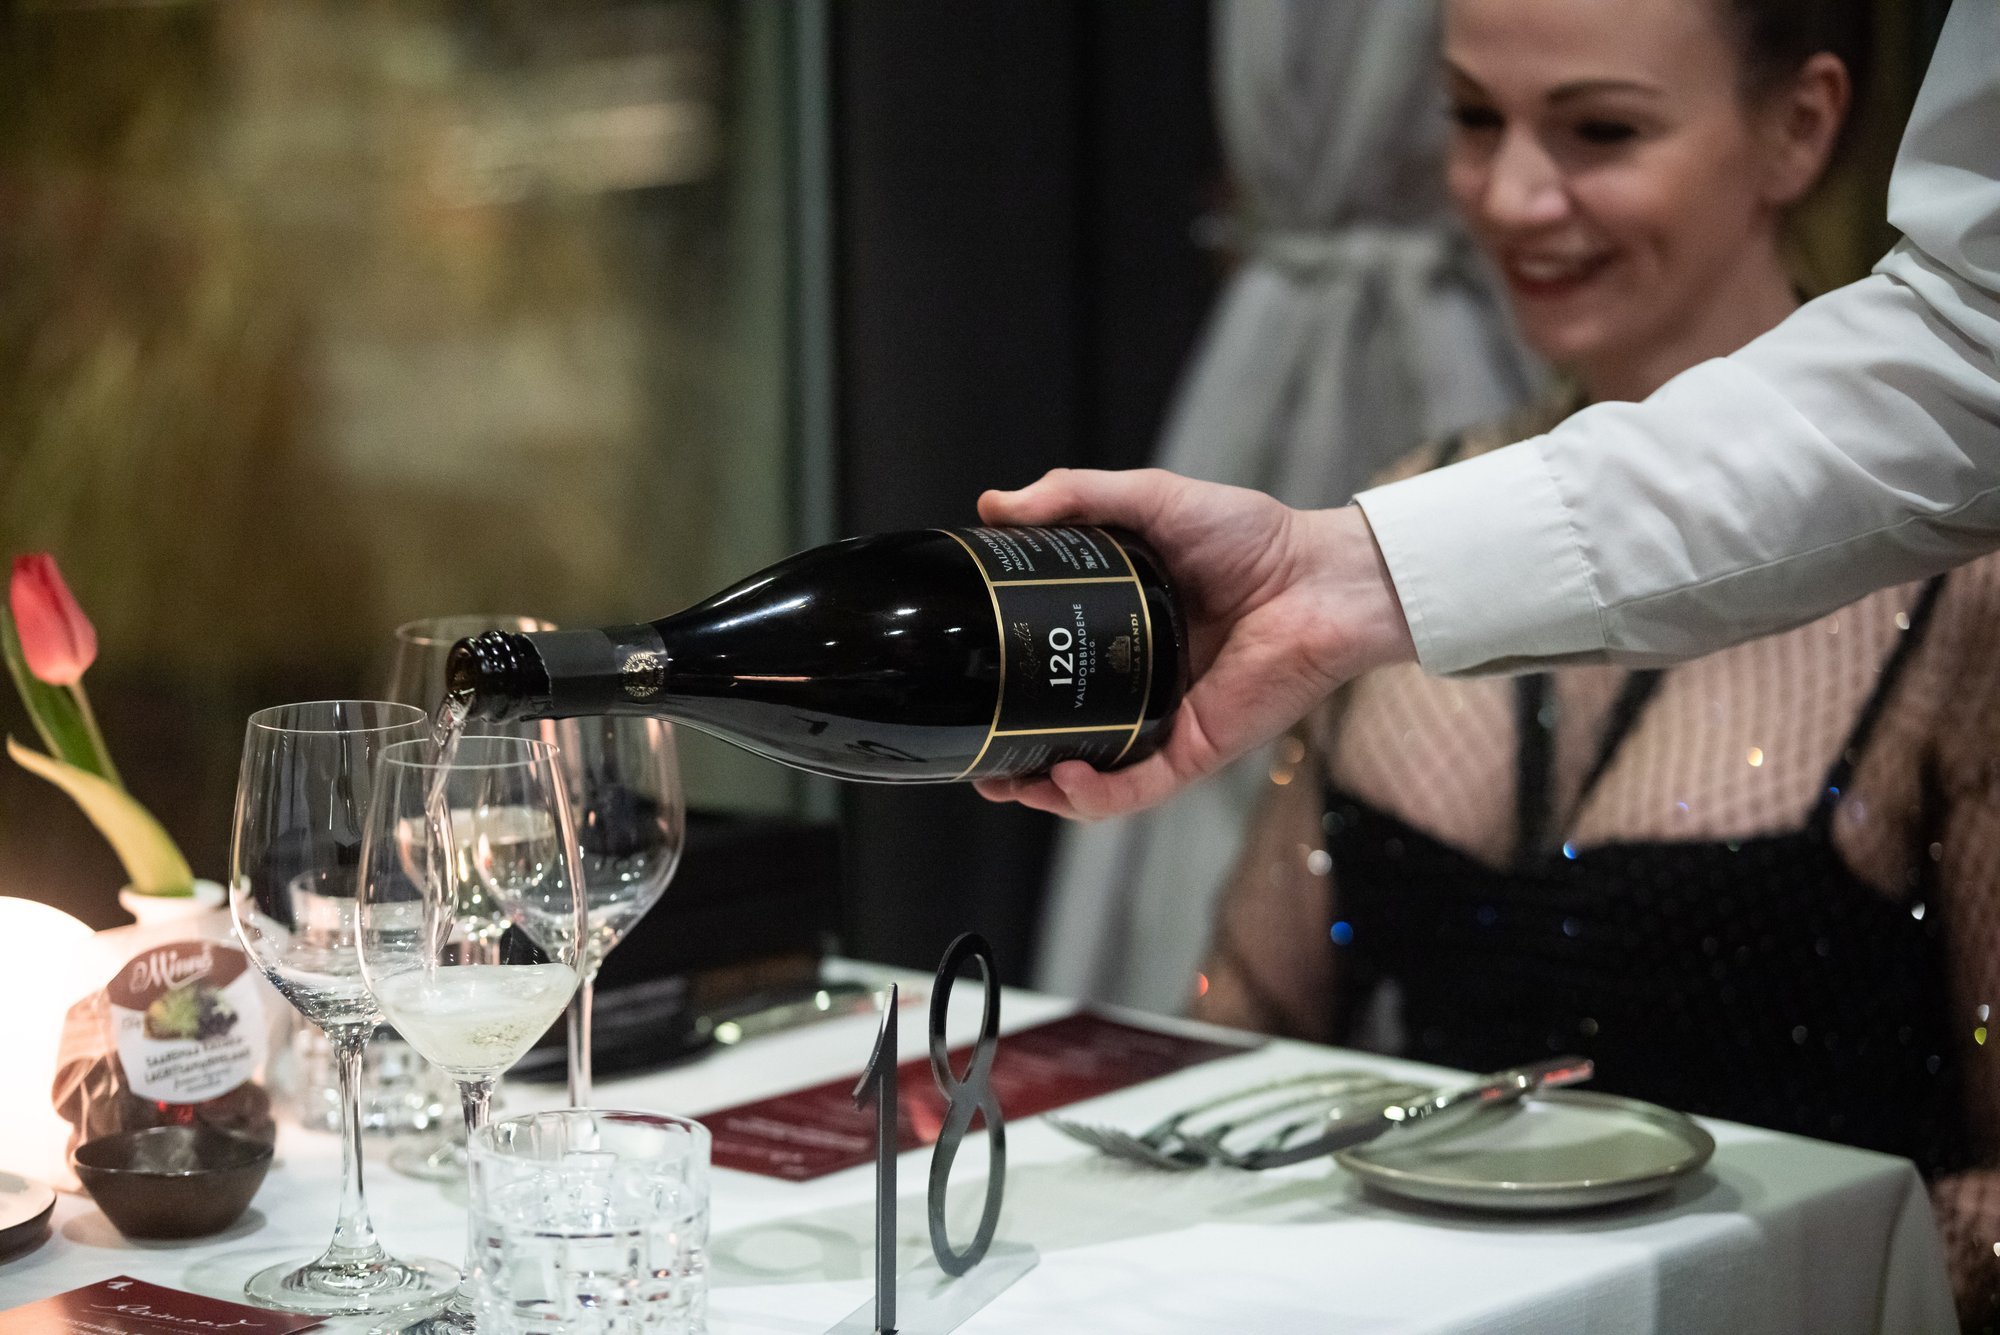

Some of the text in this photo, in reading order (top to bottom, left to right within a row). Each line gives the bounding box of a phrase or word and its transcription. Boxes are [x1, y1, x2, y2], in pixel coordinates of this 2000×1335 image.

[996, 537, 1025, 571] PROSECCO
[1049, 627, 1073, 688] 120
[1073, 603, 1088, 709] VALDOBBIADENE
[1130, 614, 1141, 653] SANDI
[852, 932, 1007, 1335] 18
